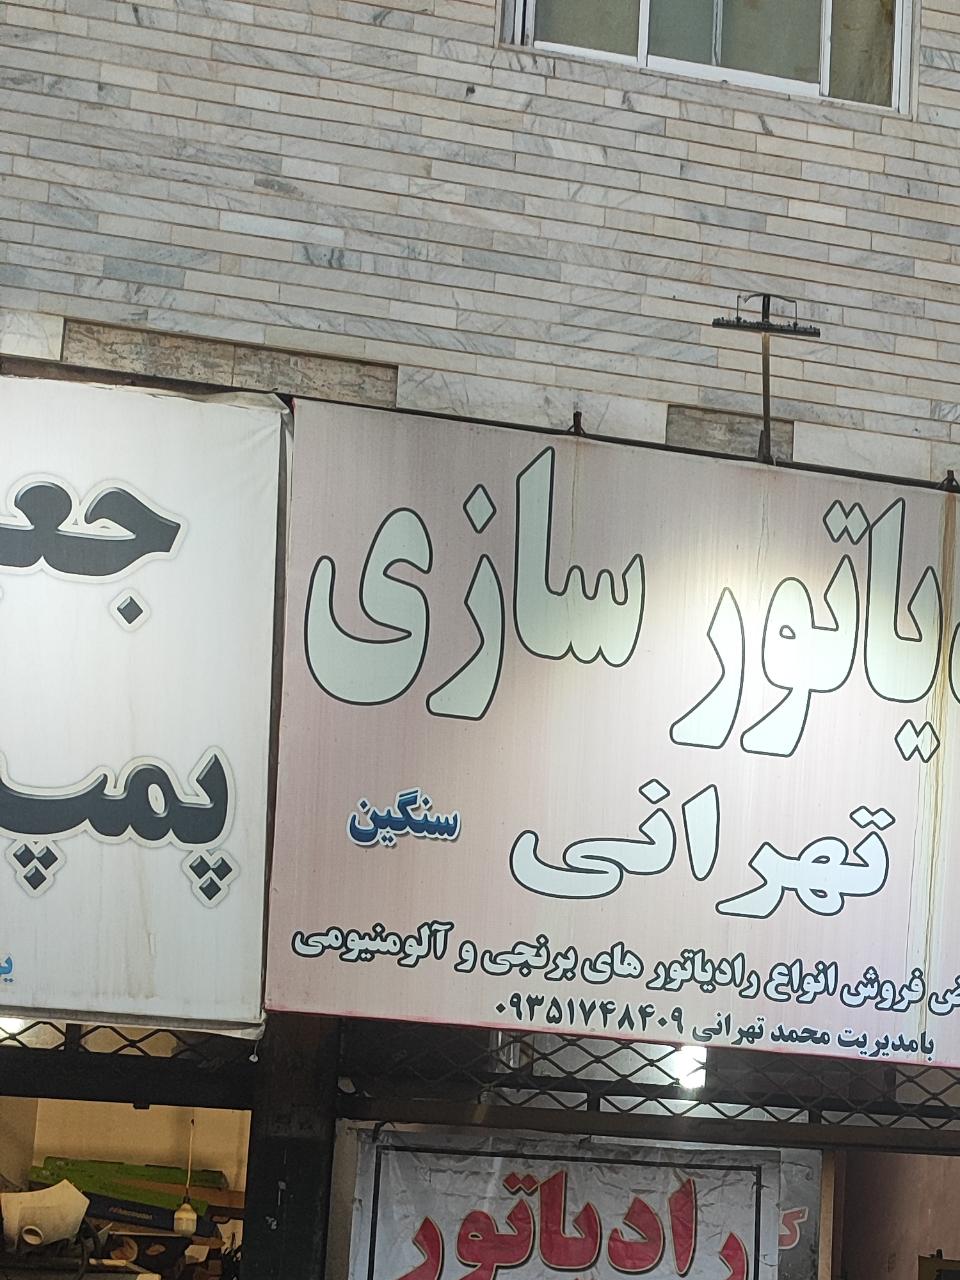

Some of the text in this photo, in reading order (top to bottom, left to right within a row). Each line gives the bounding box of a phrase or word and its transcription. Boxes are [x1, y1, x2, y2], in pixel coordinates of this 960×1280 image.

[0, 480, 181, 625] جع
[304, 445, 647, 721] سازی
[349, 786, 462, 850] سنگین
[510, 779, 896, 920] تهرانی
[290, 918, 455, 968] آلومنیومی
[453, 938, 478, 973] و
[480, 932, 579, 983] برنجی
[580, 941, 645, 985] های
[646, 948, 760, 996] رادیاتور
[764, 959, 839, 1006] انواع
[839, 964, 926, 1011] فروش
[496, 992, 936, 1063] بامدیریت محمد تهرانی ۰۹۳۵۱۷۴۸۴۰۹
